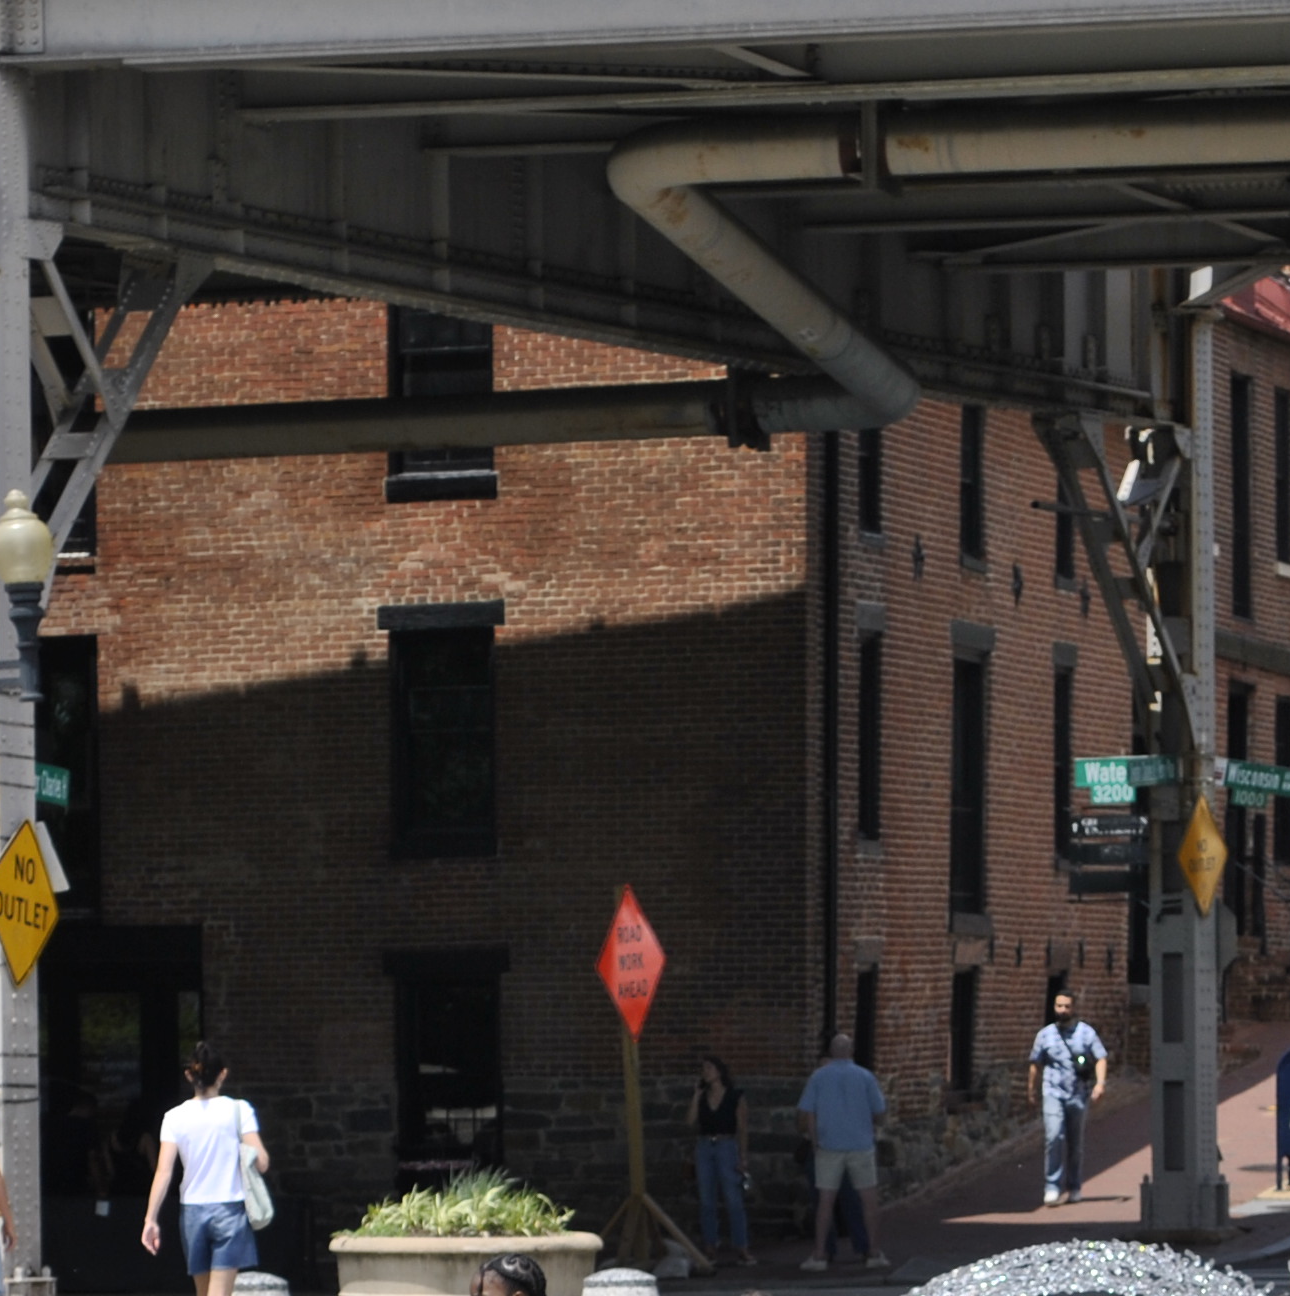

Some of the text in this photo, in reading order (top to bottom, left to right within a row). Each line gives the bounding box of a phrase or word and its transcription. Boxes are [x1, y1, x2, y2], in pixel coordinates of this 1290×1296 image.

[1084, 761, 1127, 783] Wate
[1227, 762, 1280, 790] Wisconsin
[1093, 784, 1134, 802] 3200
[1235, 789, 1264, 806] 1000
[14, 853, 35, 884] NO
[617, 924, 643, 944] ROAD
[619, 951, 645, 971] WORK
[618, 979, 648, 998] AHEAD
